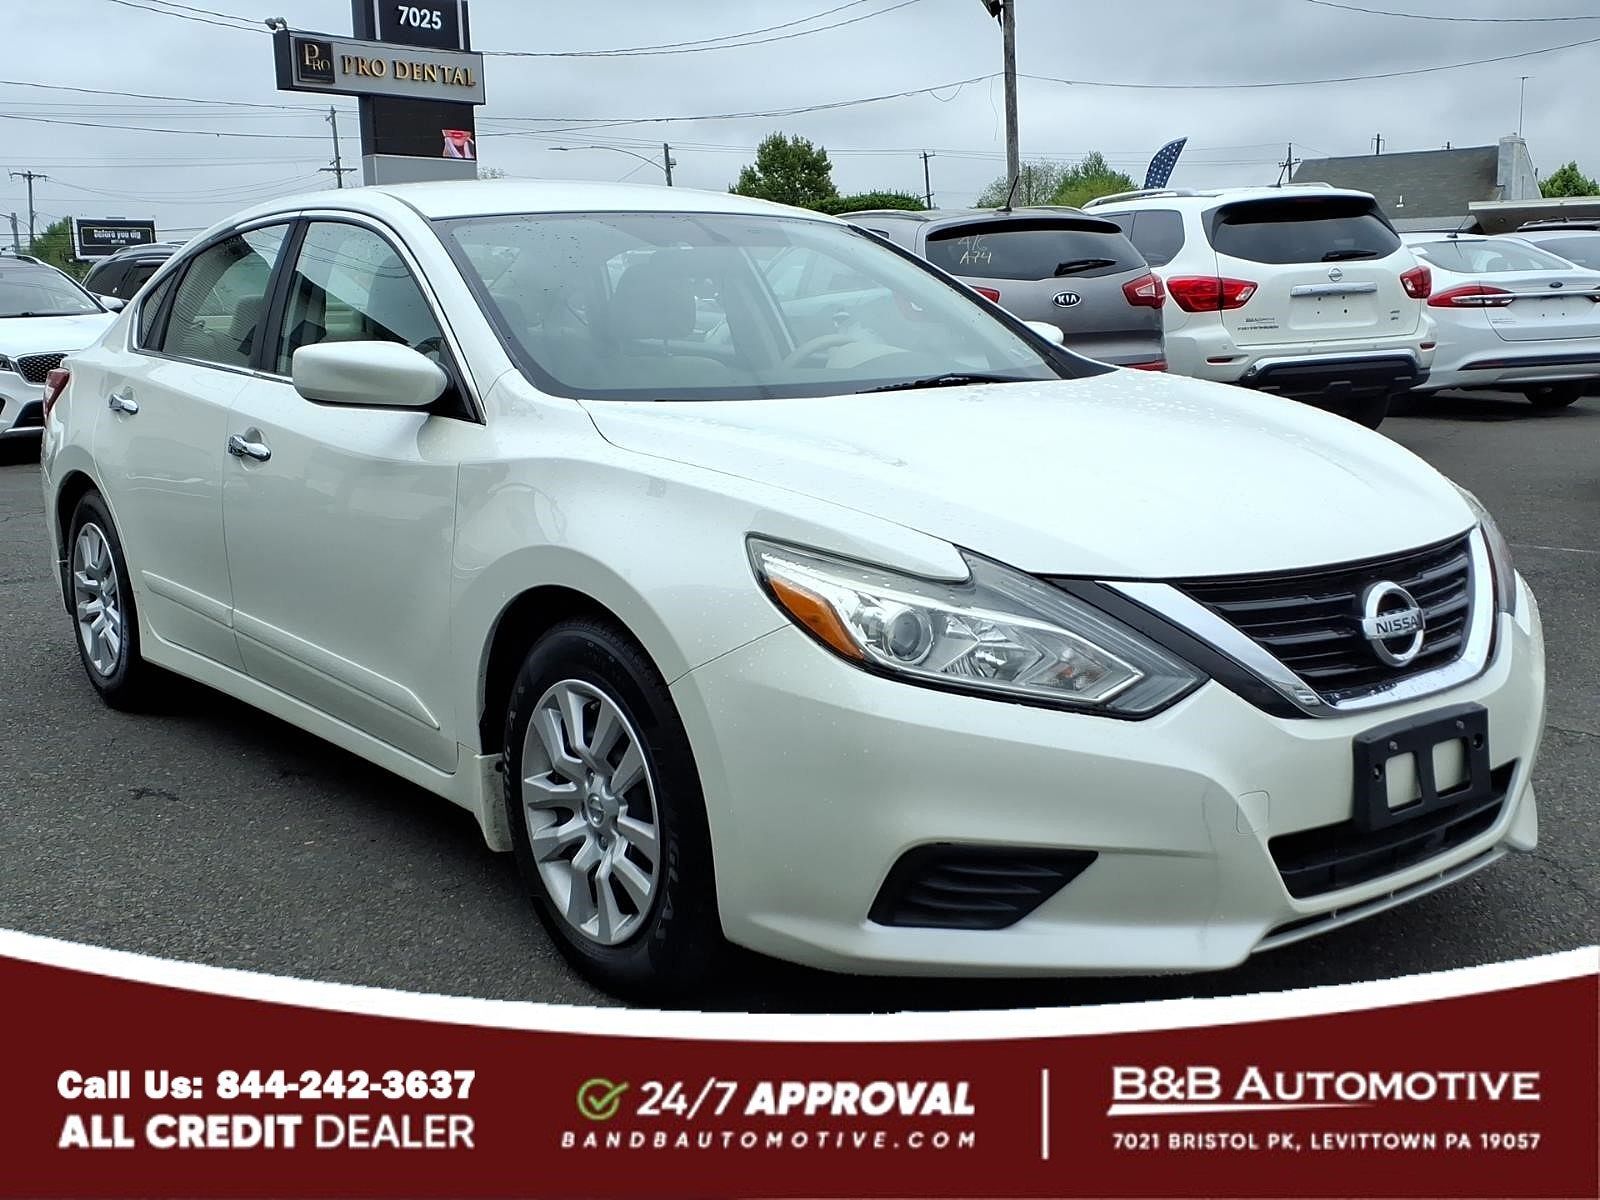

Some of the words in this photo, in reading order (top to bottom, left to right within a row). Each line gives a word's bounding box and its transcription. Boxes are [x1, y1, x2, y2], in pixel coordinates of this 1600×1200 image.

[399, 6, 441, 29] 7025
[341, 55, 387, 78] PRO
[394, 60, 477, 87] DENTAL
